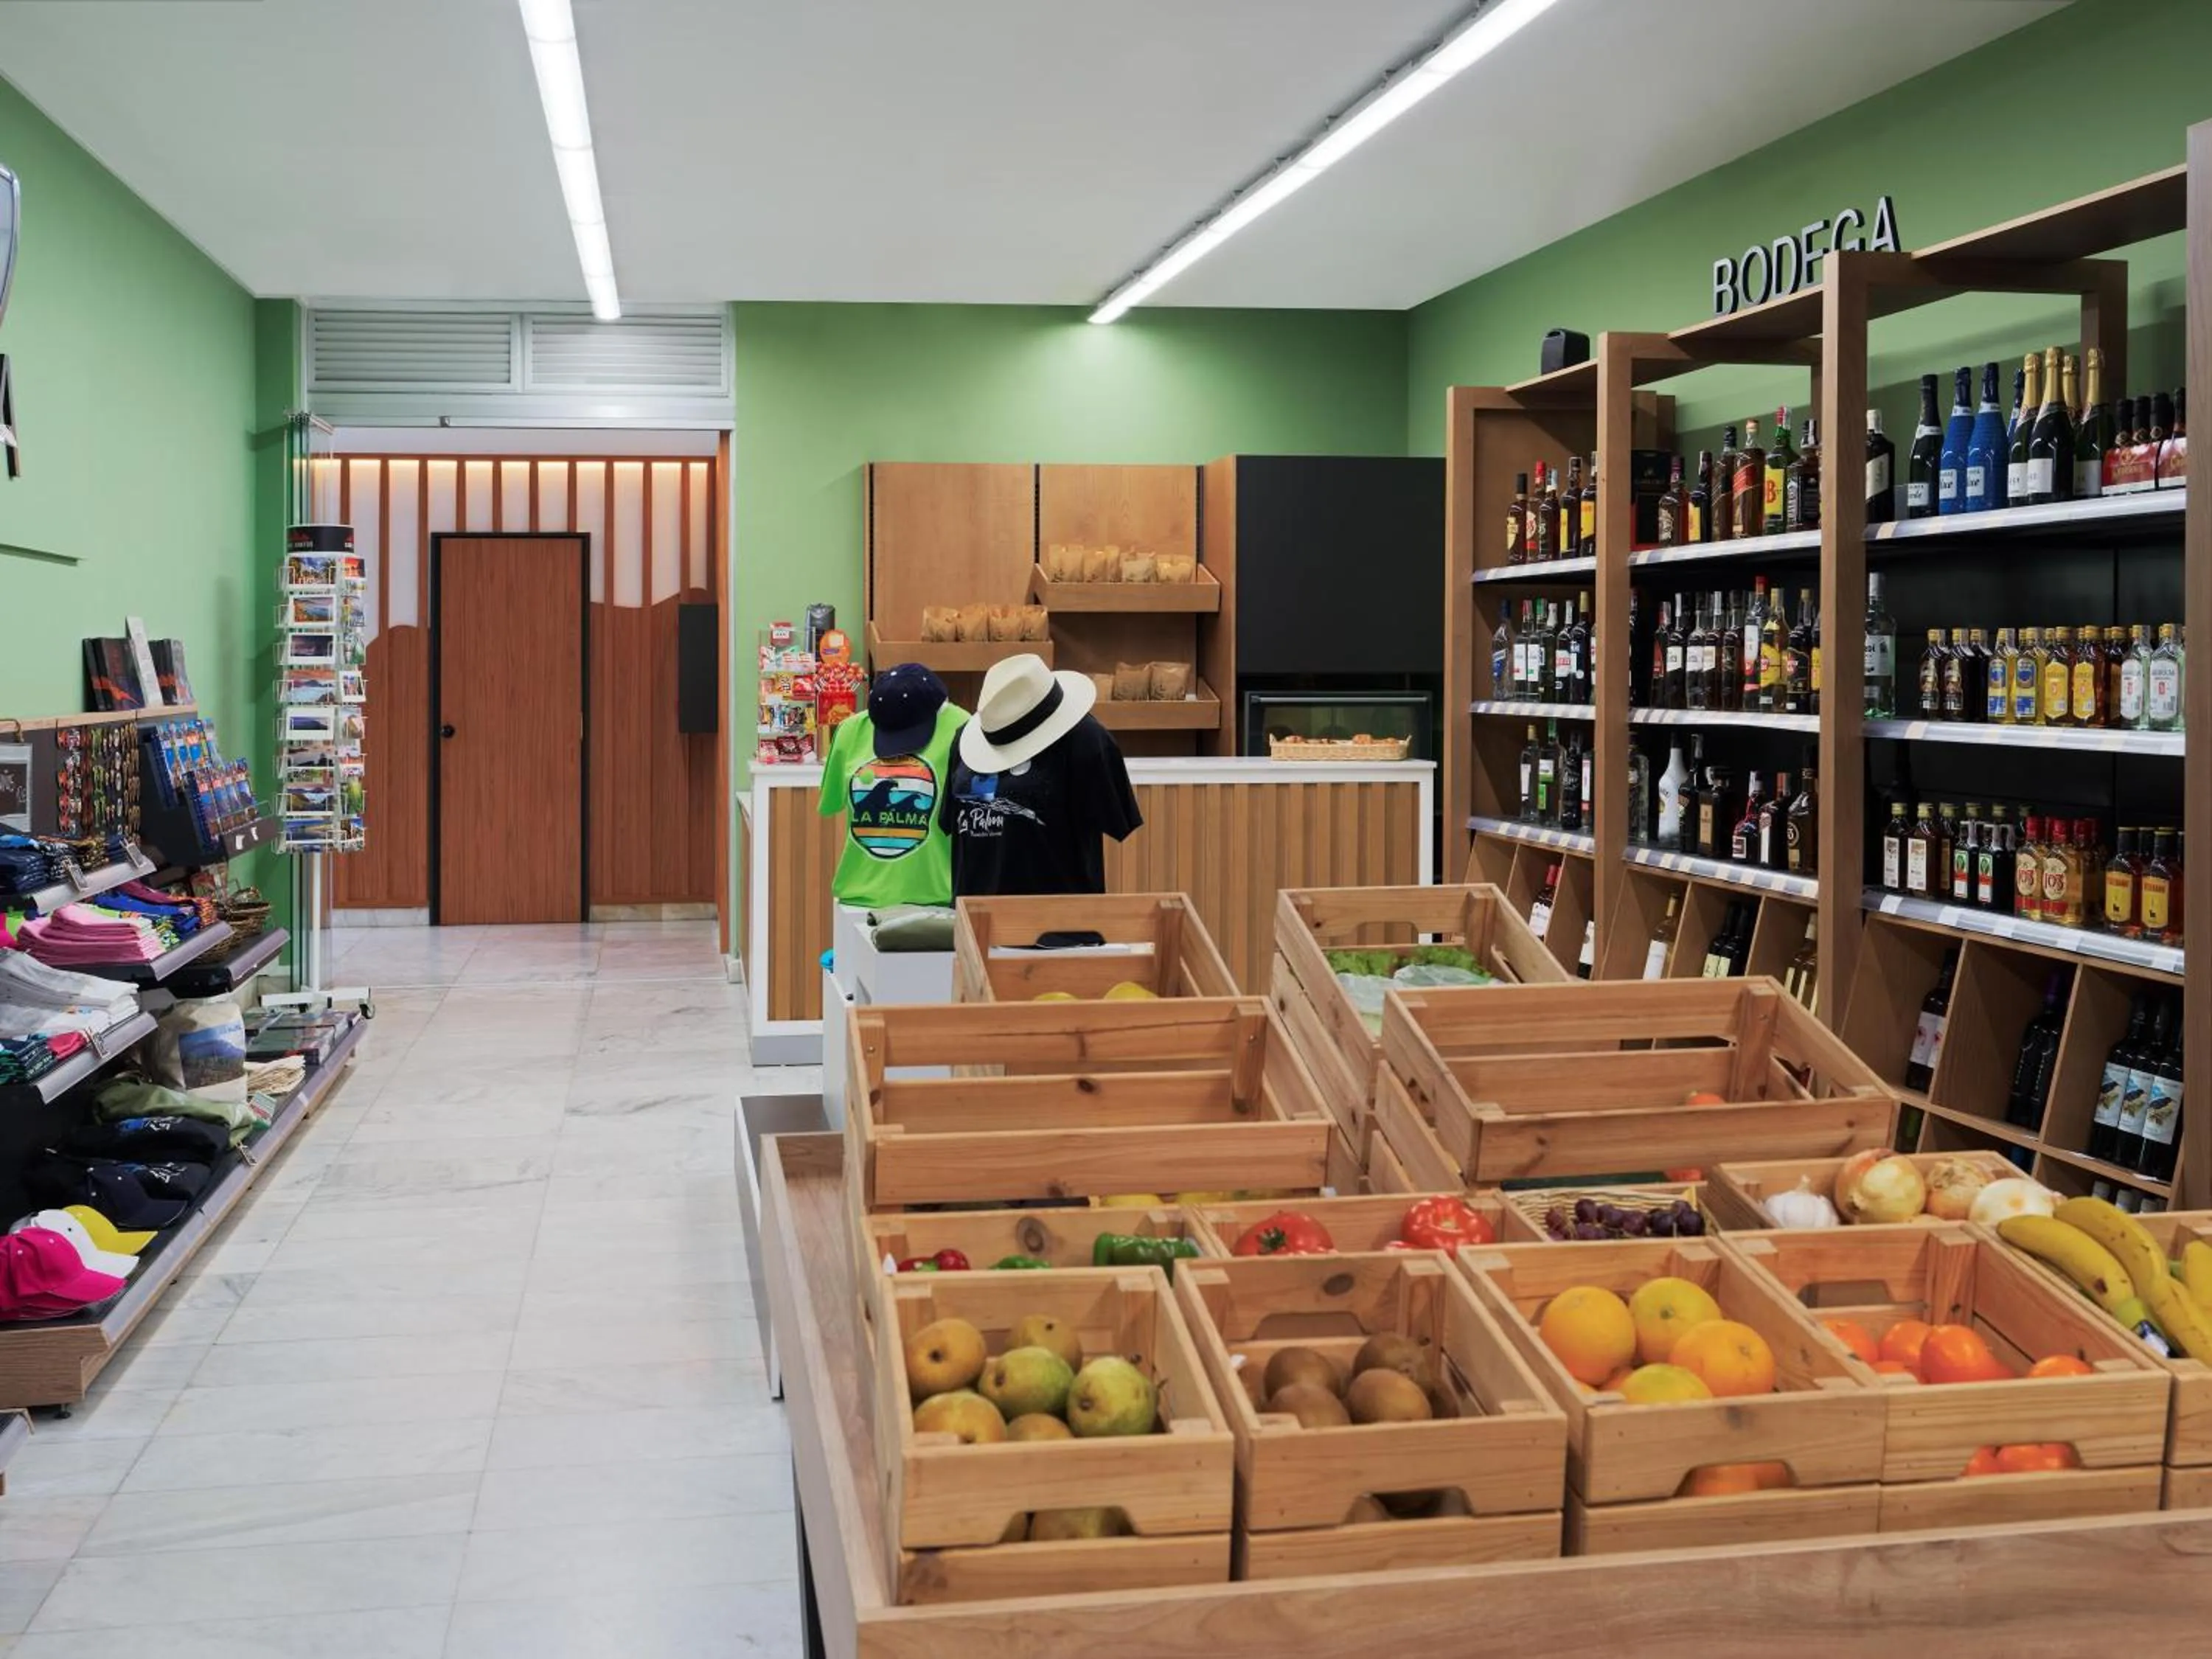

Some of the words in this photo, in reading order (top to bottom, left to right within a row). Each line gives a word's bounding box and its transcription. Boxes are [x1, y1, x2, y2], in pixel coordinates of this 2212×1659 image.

[1713, 195, 1902, 316] BODEGA
[852, 811, 872, 823] LA
[878, 810, 929, 826] PALMA
